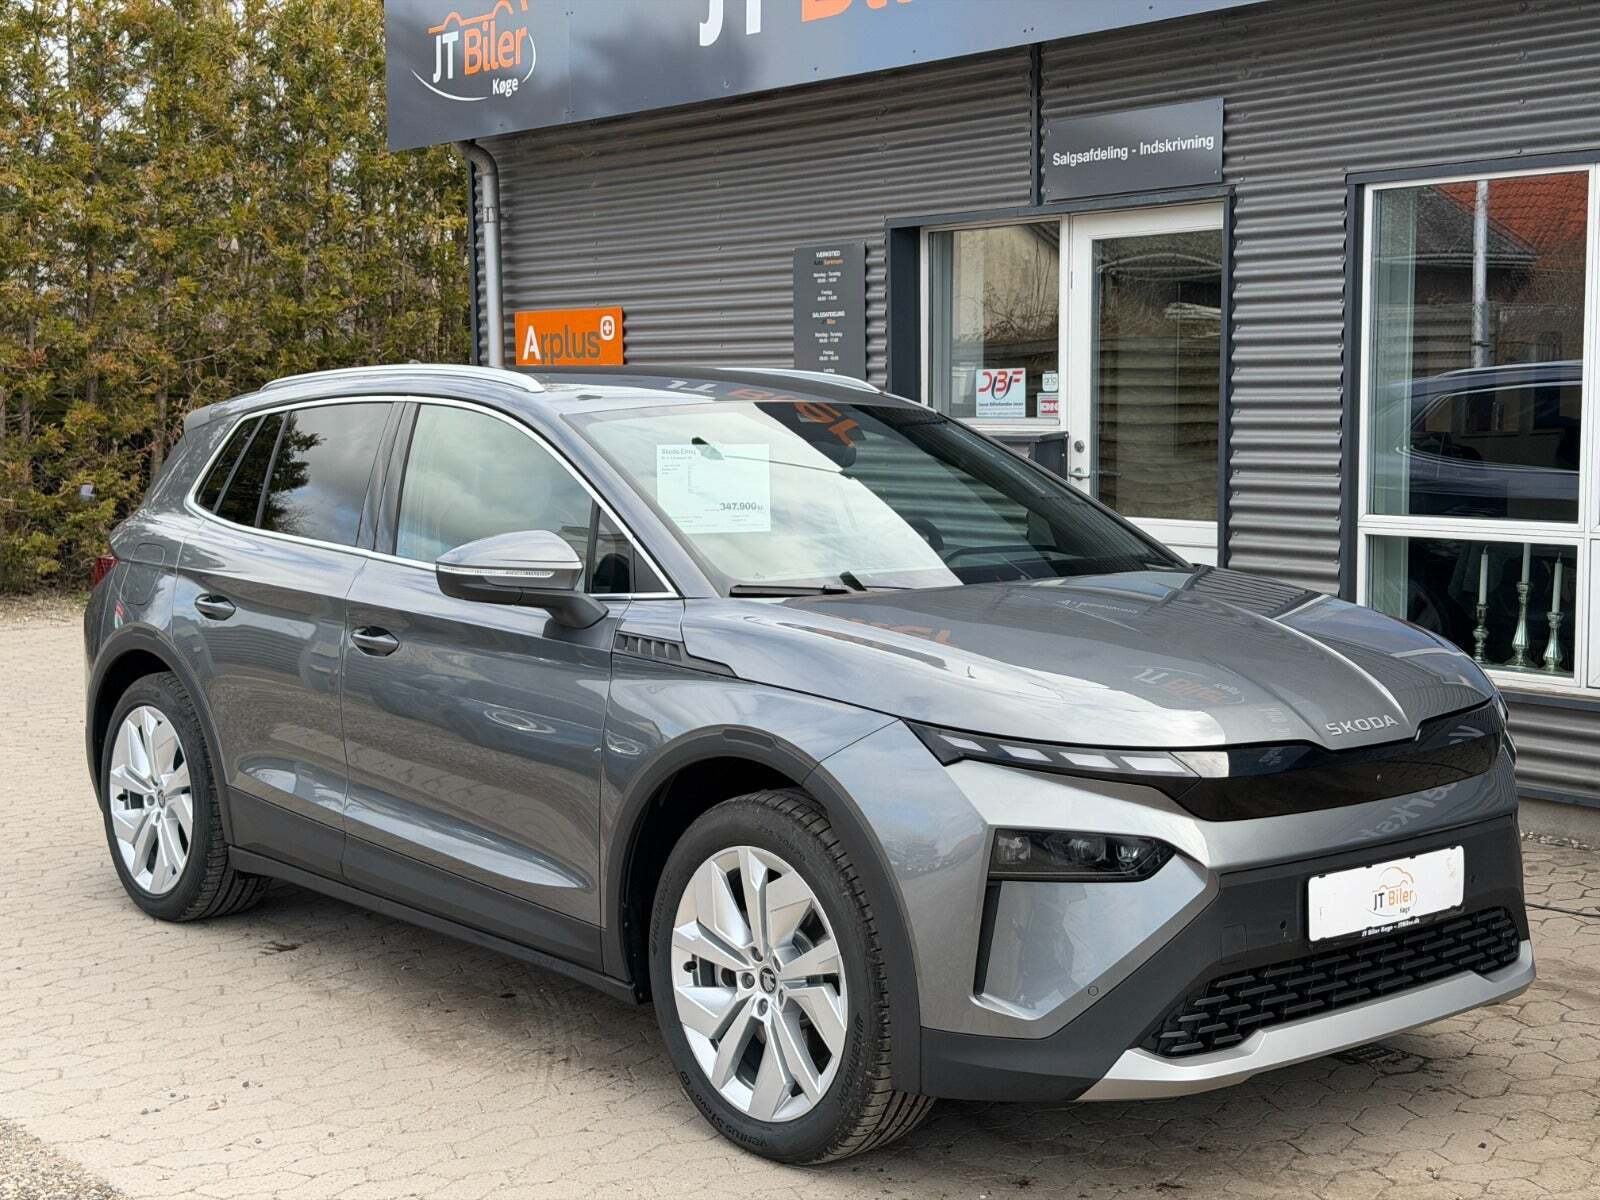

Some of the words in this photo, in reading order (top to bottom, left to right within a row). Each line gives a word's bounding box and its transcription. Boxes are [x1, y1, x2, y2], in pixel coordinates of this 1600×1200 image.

[433, 30, 459, 83] JT
[464, 20, 528, 75] Biler
[492, 77, 519, 97] Køge
[1052, 146, 1129, 167] Salgsafdeling
[1139, 134, 1215, 156] Indskrivning
[1326, 714, 1399, 736] SKODA
[1374, 892, 1385, 911] JT
[1388, 888, 1414, 906] Biler
